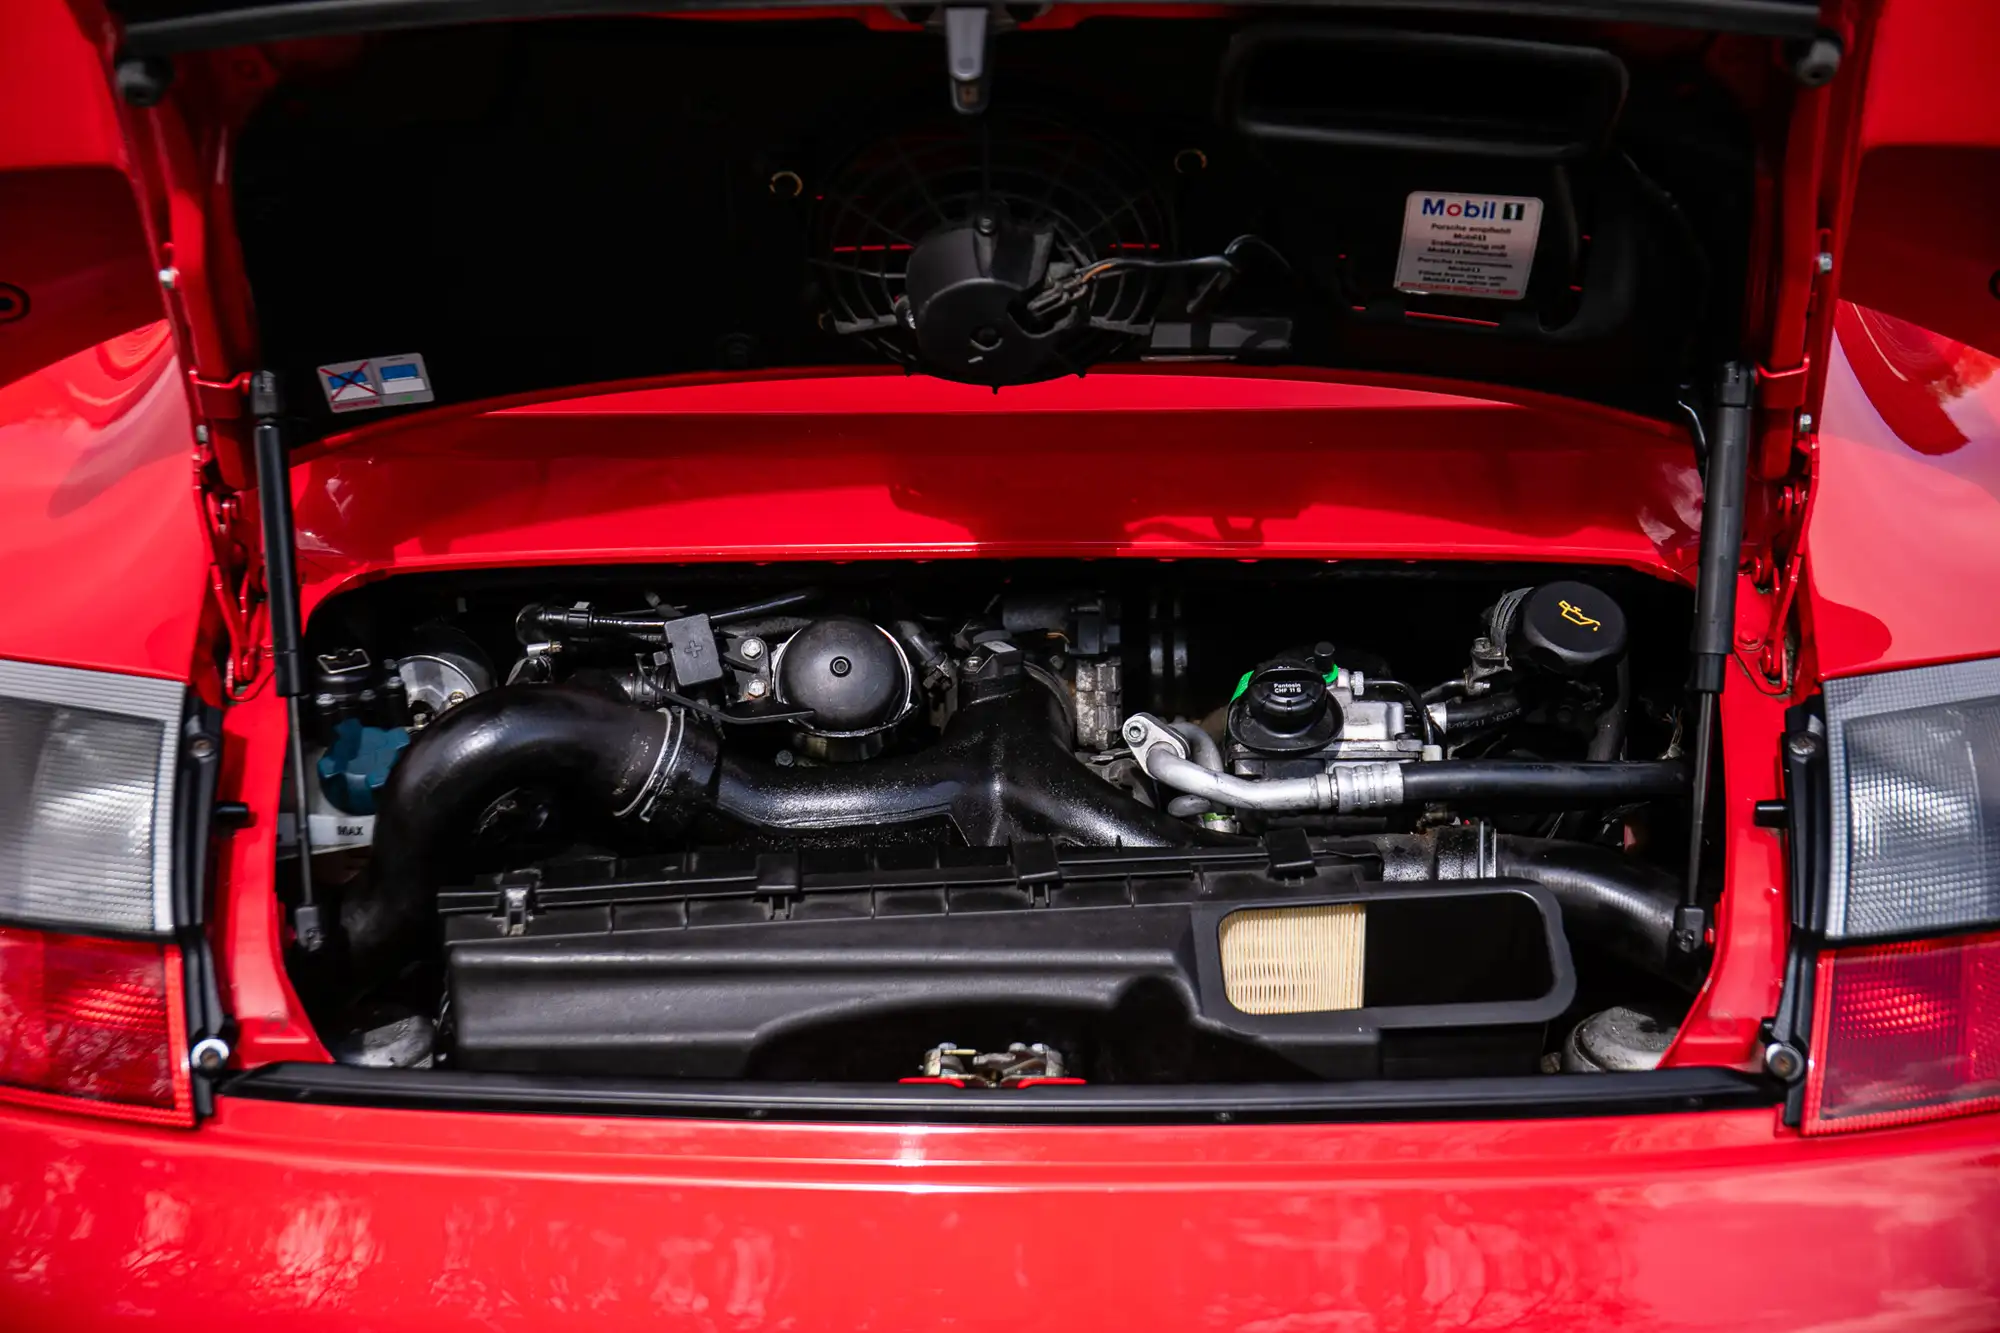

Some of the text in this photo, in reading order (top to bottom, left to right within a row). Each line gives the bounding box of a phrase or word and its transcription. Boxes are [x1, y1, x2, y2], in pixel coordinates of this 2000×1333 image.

[1422, 197, 1522, 220] Mobil 1
[1431, 223, 1466, 231] Porsche
[1417, 257, 1453, 265] Porsche
[337, 825, 364, 836] MAX
